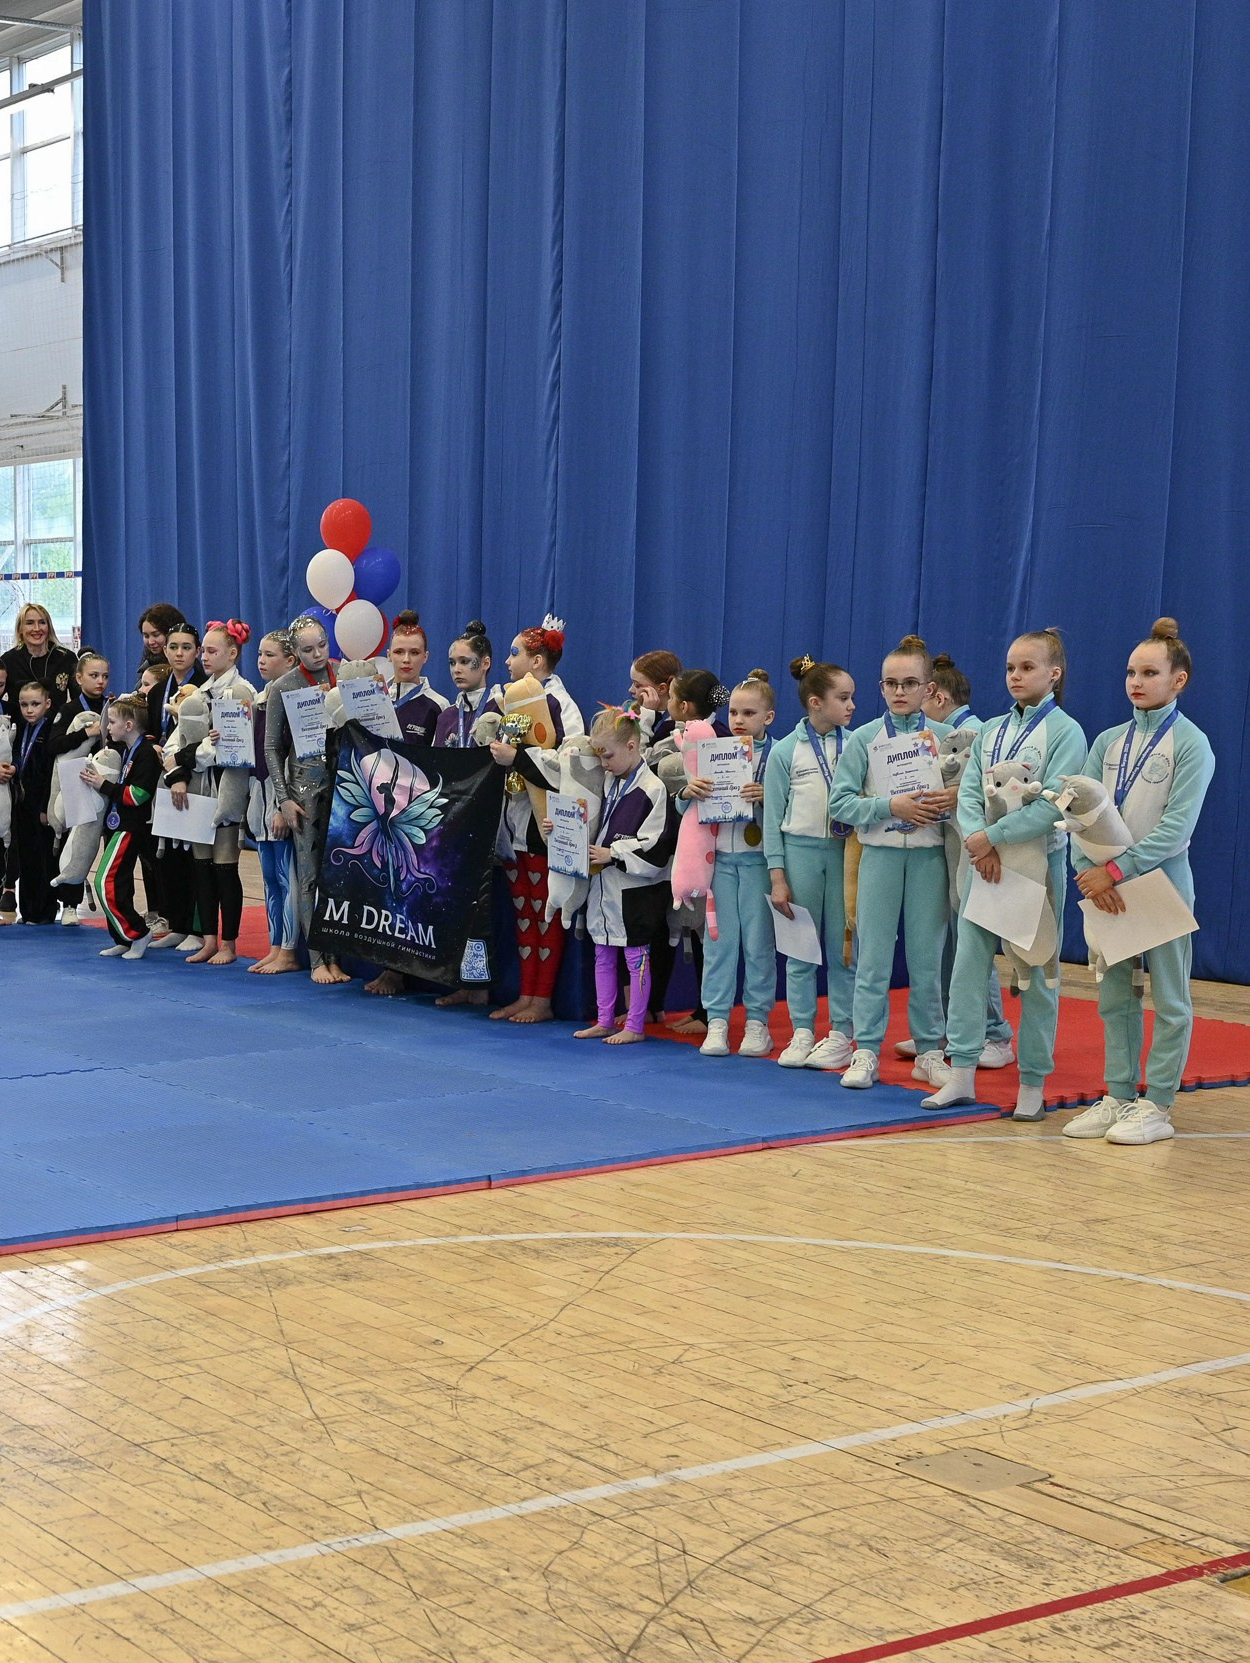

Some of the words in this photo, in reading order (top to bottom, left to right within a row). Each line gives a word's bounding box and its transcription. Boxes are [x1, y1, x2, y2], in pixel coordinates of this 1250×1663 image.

[352, 689, 376, 700] ДИПЛОМ
[297, 697, 321, 709] ДИПЛОМ
[710, 752, 738, 762] ДИПЛОМ
[887, 749, 921, 765] ДИПЛОМ
[323, 898, 350, 924] M
[360, 905, 437, 948] DREAM
[321, 927, 350, 937] школа
[354, 933, 395, 948] воздушной
[397, 945, 436, 960] гимнастики
